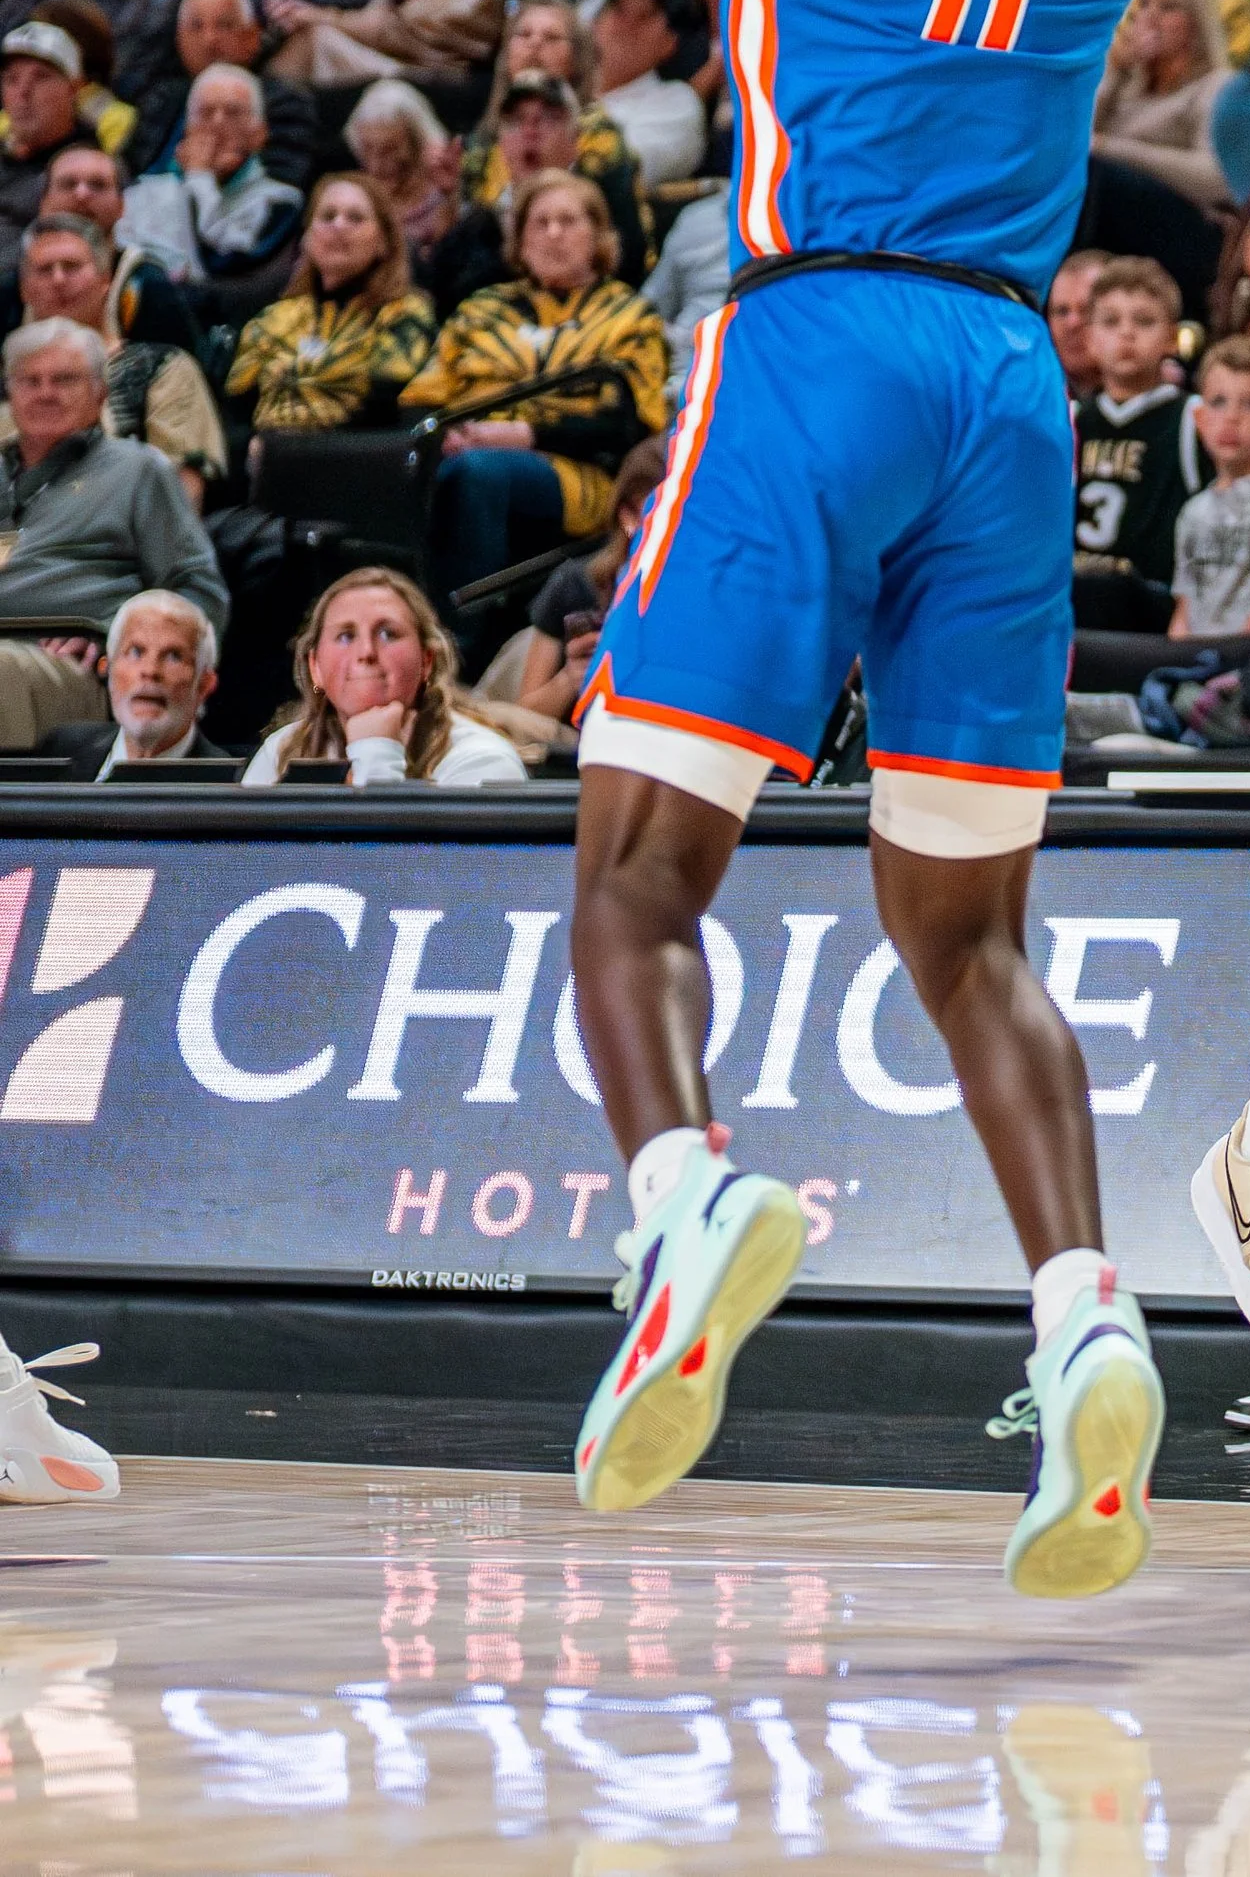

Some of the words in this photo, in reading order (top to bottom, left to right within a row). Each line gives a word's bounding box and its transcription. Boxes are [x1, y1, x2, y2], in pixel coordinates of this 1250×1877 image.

[1076, 479, 1127, 550] 3
[385, 1168, 837, 1245] HOTS
[371, 1269, 527, 1291] DAKTRONICS
